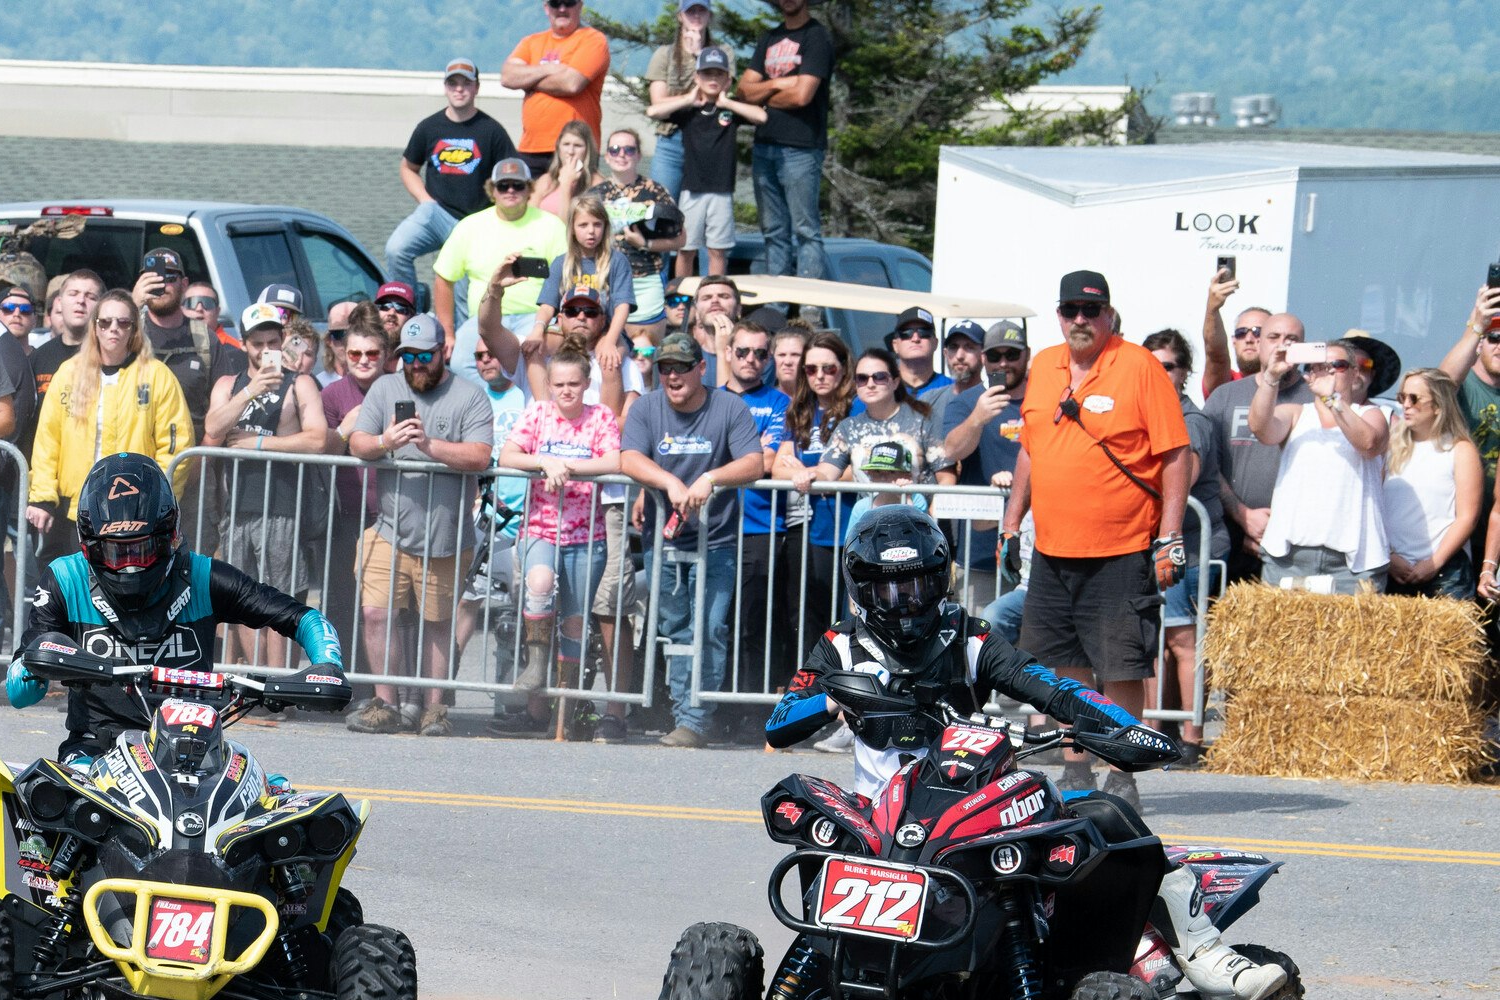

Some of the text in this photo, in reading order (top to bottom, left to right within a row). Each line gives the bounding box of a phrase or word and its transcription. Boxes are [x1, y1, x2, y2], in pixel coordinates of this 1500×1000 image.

[1175, 211, 1261, 234] LOOK
[100, 520, 149, 536] LEATT
[167, 586, 192, 621] LEATT
[165, 704, 214, 729] 784
[942, 731, 998, 754] 212
[997, 770, 1032, 792] can-am
[843, 864, 908, 882] BURKE MARSIGLIA
[820, 878, 923, 930] 212
[150, 911, 214, 948] 784
